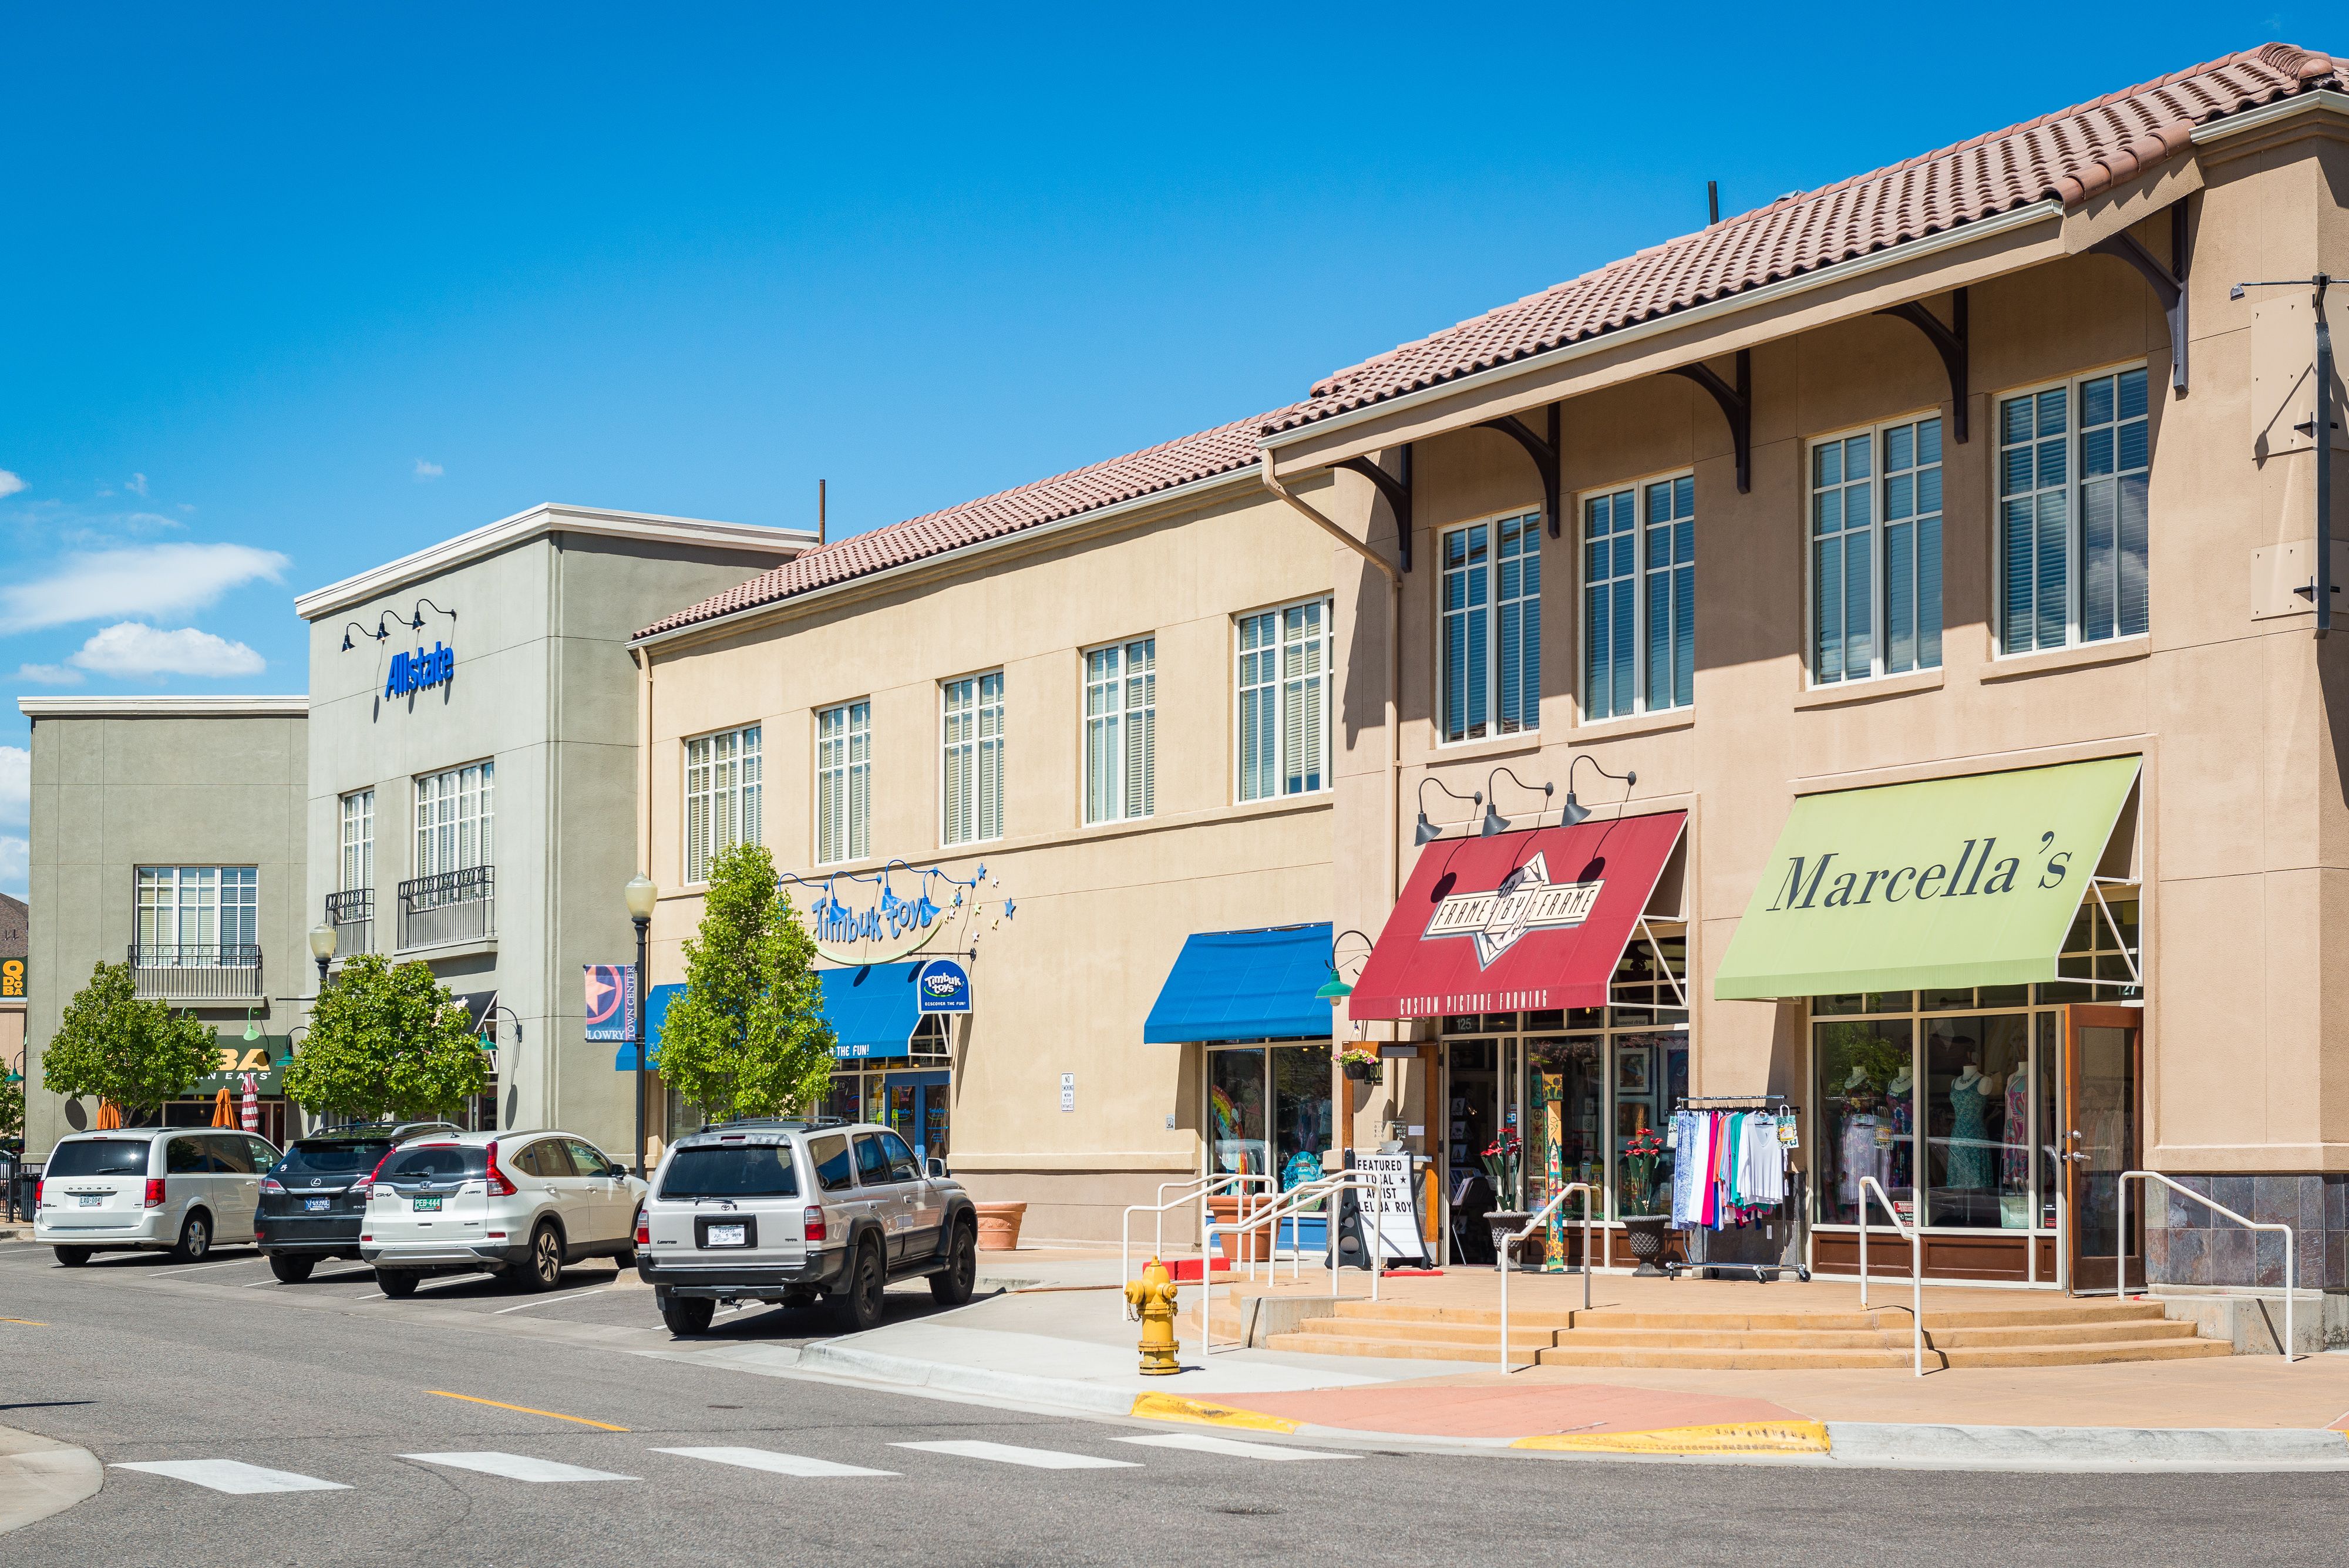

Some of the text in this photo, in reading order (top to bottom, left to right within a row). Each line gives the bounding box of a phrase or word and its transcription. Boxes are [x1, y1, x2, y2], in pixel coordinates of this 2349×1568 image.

[385, 641, 454, 698] Allstate
[1766, 831, 2072, 911] Marcella's
[1435, 890, 1595, 926] FRAME BY FRAME
[812, 897, 883, 943] Timbuk
[924, 973, 961, 987] Timbuk
[932, 984, 954, 994] toys
[1401, 990, 1546, 1015] CUSTOM PICTURE FRAMING
[1456, 1018, 1470, 1030] 125
[587, 1030, 625, 1040] LOWRY
[837, 1046, 850, 1056] THE
[853, 1044, 869, 1056] FUN!
[1370, 1064, 1382, 1078] 600
[1358, 1160, 1402, 1171] FEATURED
[1366, 1174, 1394, 1185] LOAL
[1367, 1188, 1396, 1199] AIST
[1395, 1202, 1411, 1213] ROY
